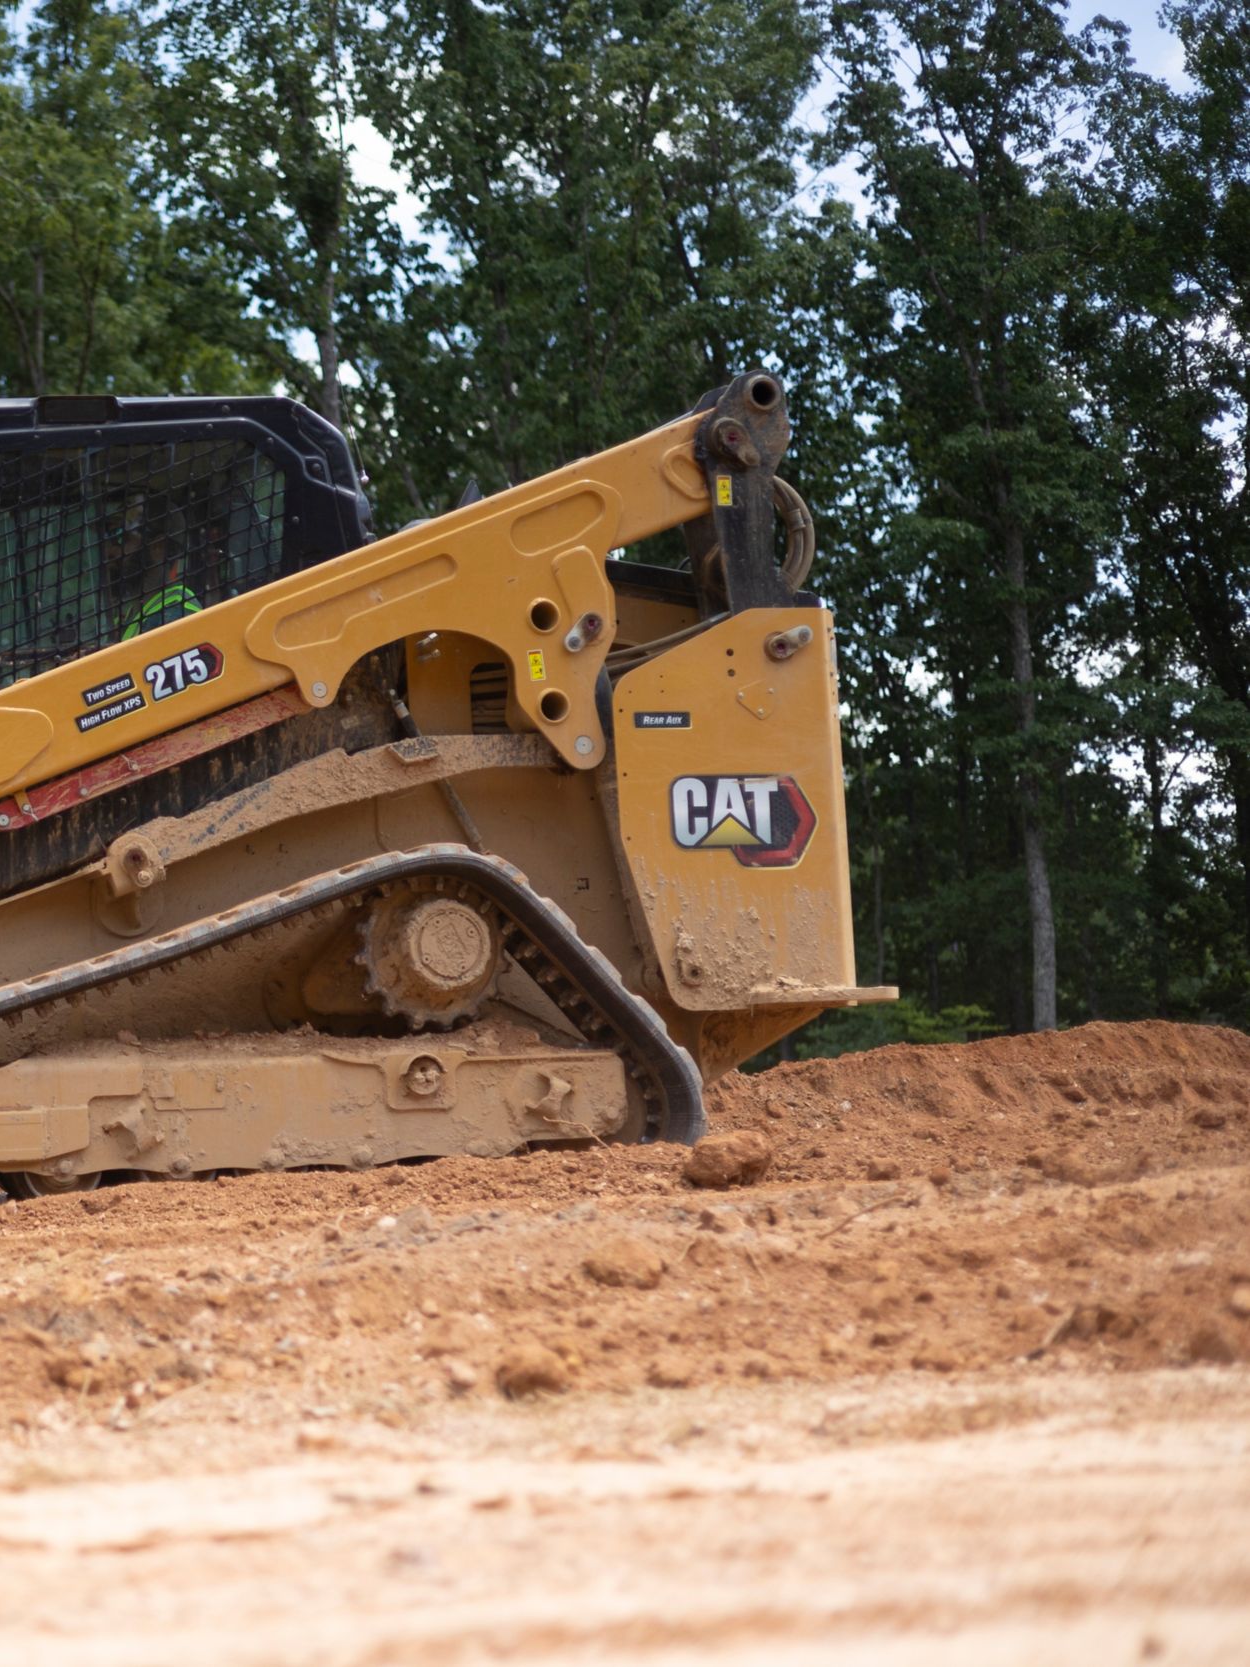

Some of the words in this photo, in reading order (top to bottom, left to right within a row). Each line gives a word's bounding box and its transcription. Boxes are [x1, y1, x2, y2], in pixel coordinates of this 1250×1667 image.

[146, 648, 208, 699] 275
[124, 696, 141, 710] XPS
[643, 715, 664, 725] REAR
[666, 715, 682, 725] AUX
[672, 777, 778, 847] CAT
